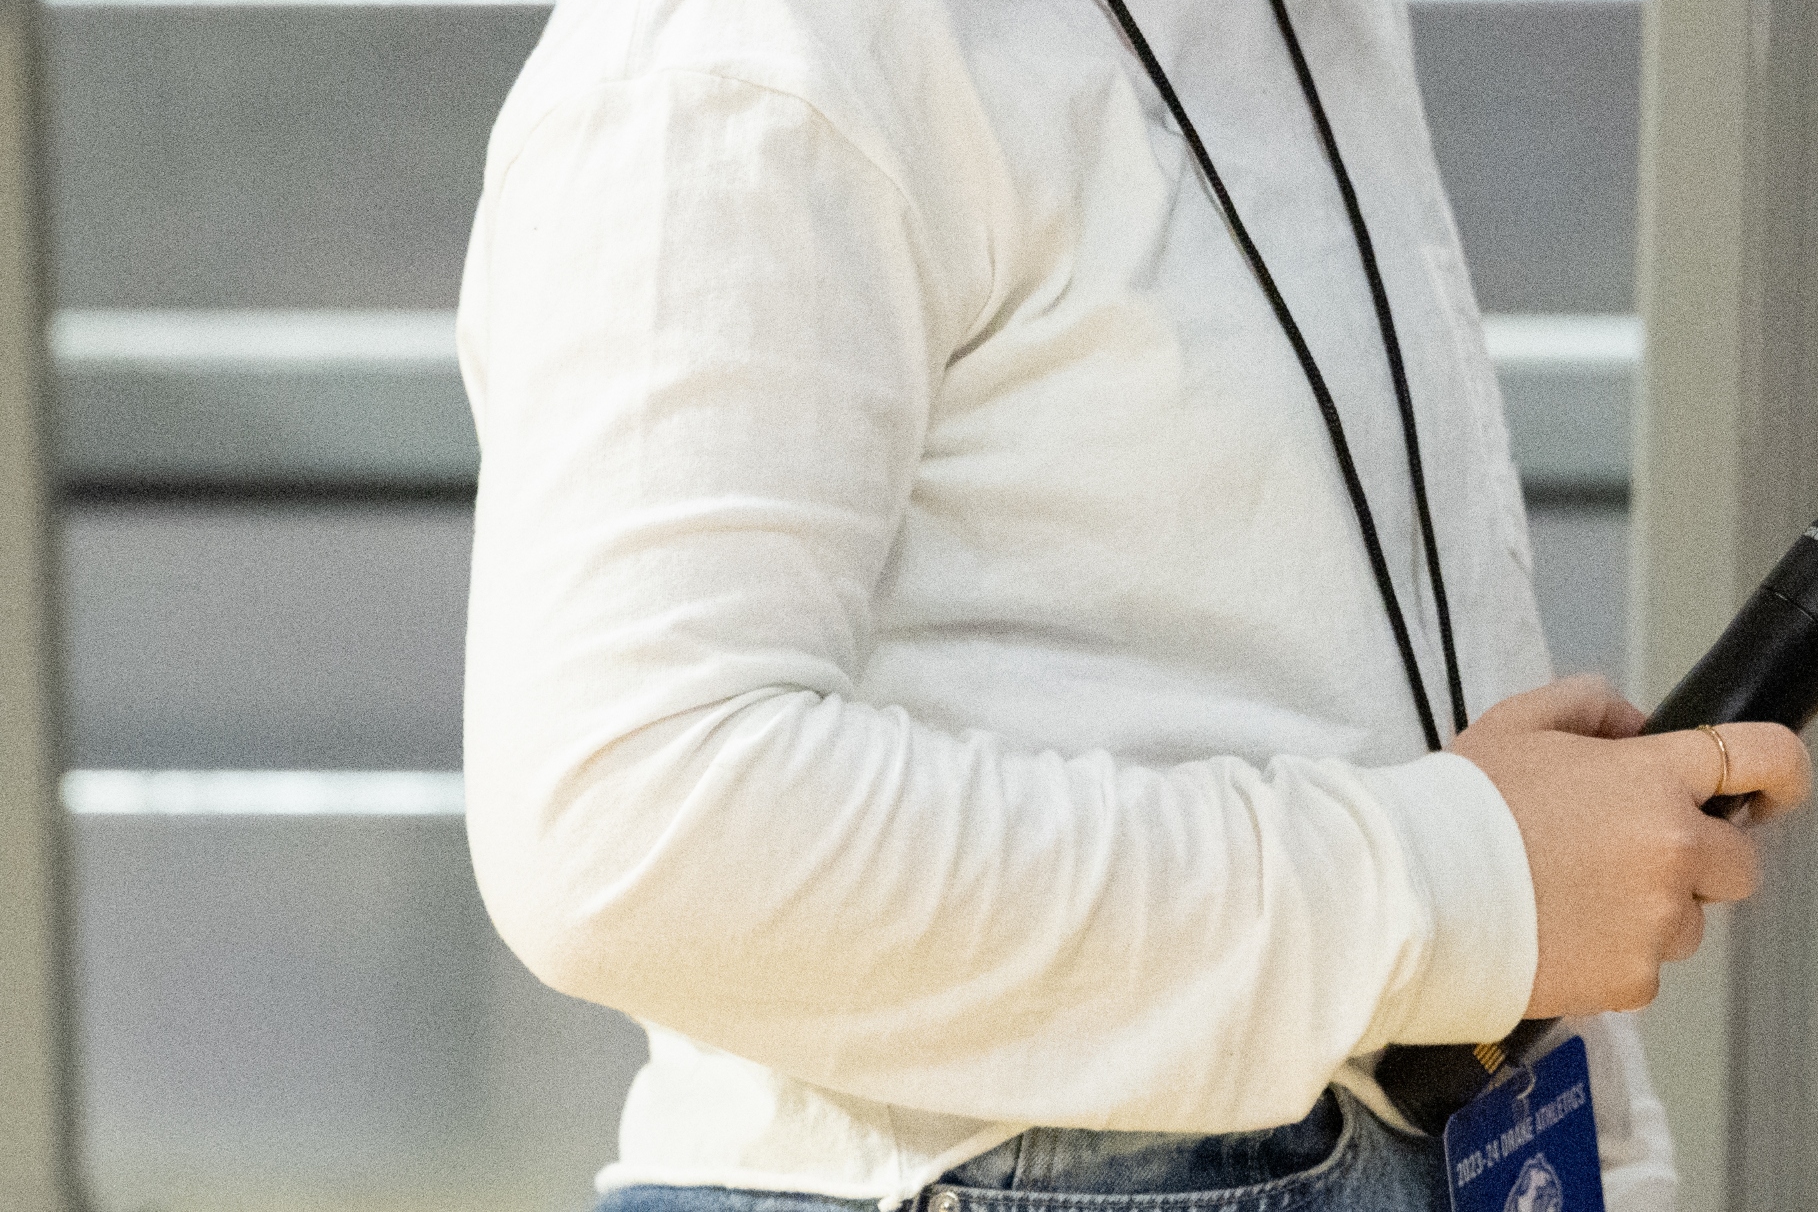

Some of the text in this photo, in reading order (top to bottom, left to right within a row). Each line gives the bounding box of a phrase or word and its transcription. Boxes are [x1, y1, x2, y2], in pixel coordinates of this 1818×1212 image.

[1456, 1081, 1586, 1188] 2023-24 DRAKE ATHLETICS
